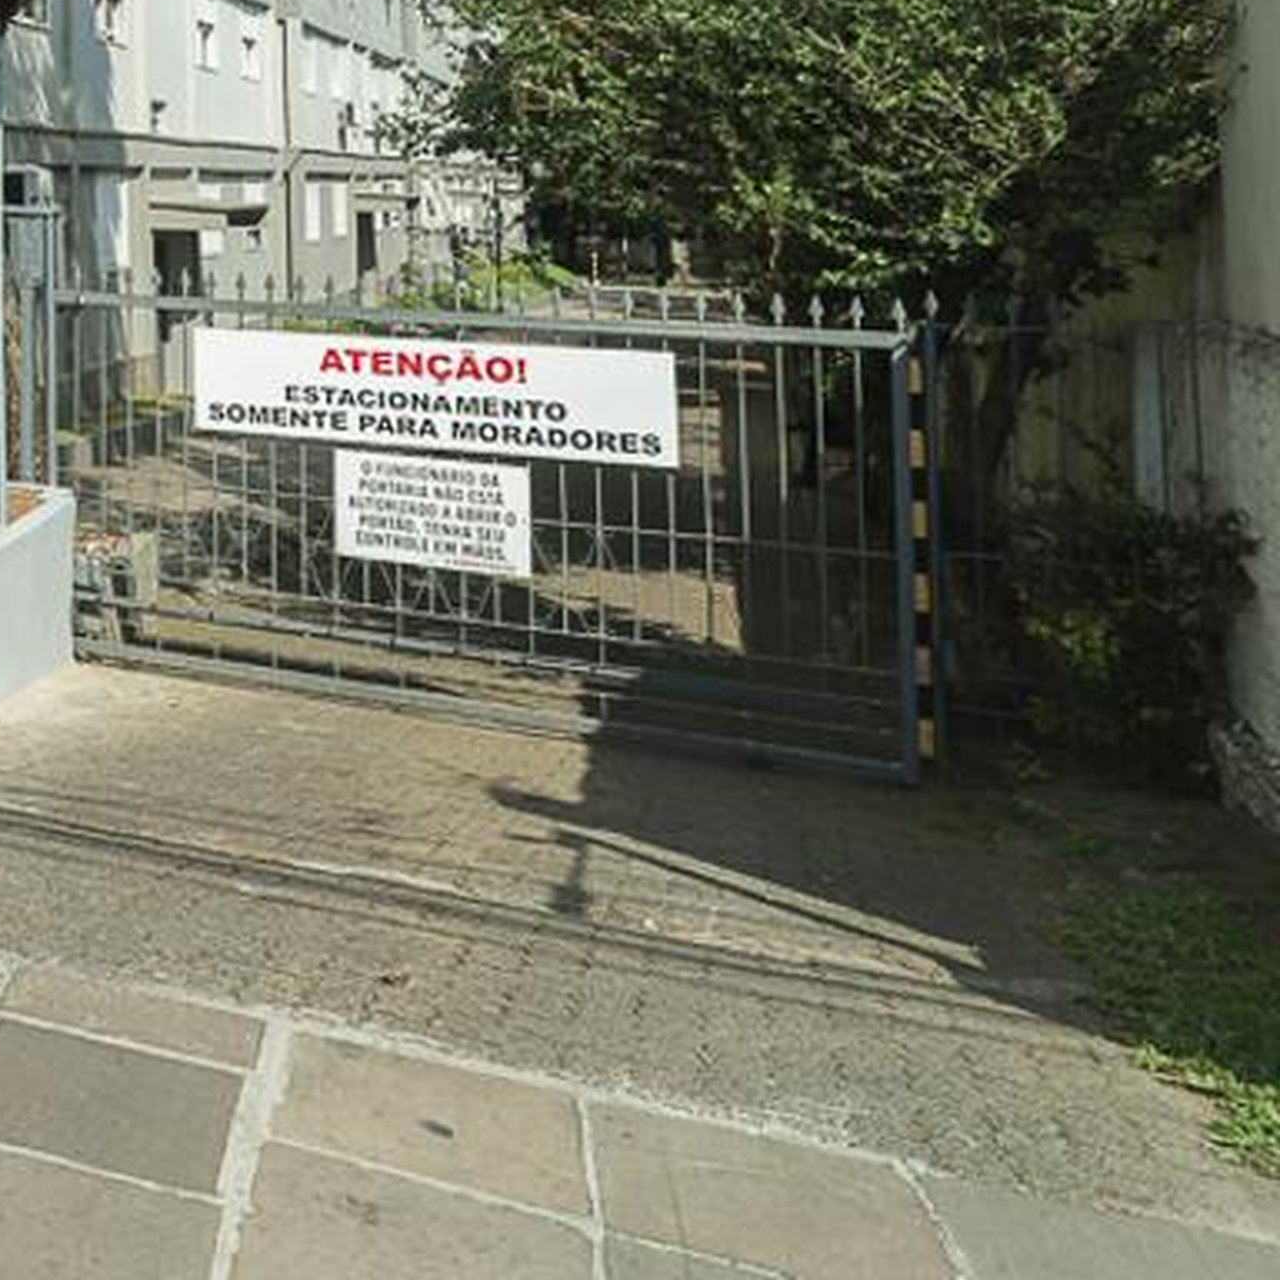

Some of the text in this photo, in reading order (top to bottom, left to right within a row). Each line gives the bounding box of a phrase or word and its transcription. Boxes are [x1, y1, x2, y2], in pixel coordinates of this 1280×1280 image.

[319, 347, 528, 386] ATENÇÃO!
[284, 384, 567, 422] ESTACIONAMENTO
[208, 401, 662, 457] SOMENTE PARA MORADORES
[358, 477, 428, 498] PORTARIA
[360, 460, 373, 475] O
[480, 471, 500, 488] DA
[348, 494, 438, 519] AUTORIZADO
[504, 510, 518, 528] O
[355, 530, 429, 554] CONTROLE
[433, 538, 458, 554] EM
